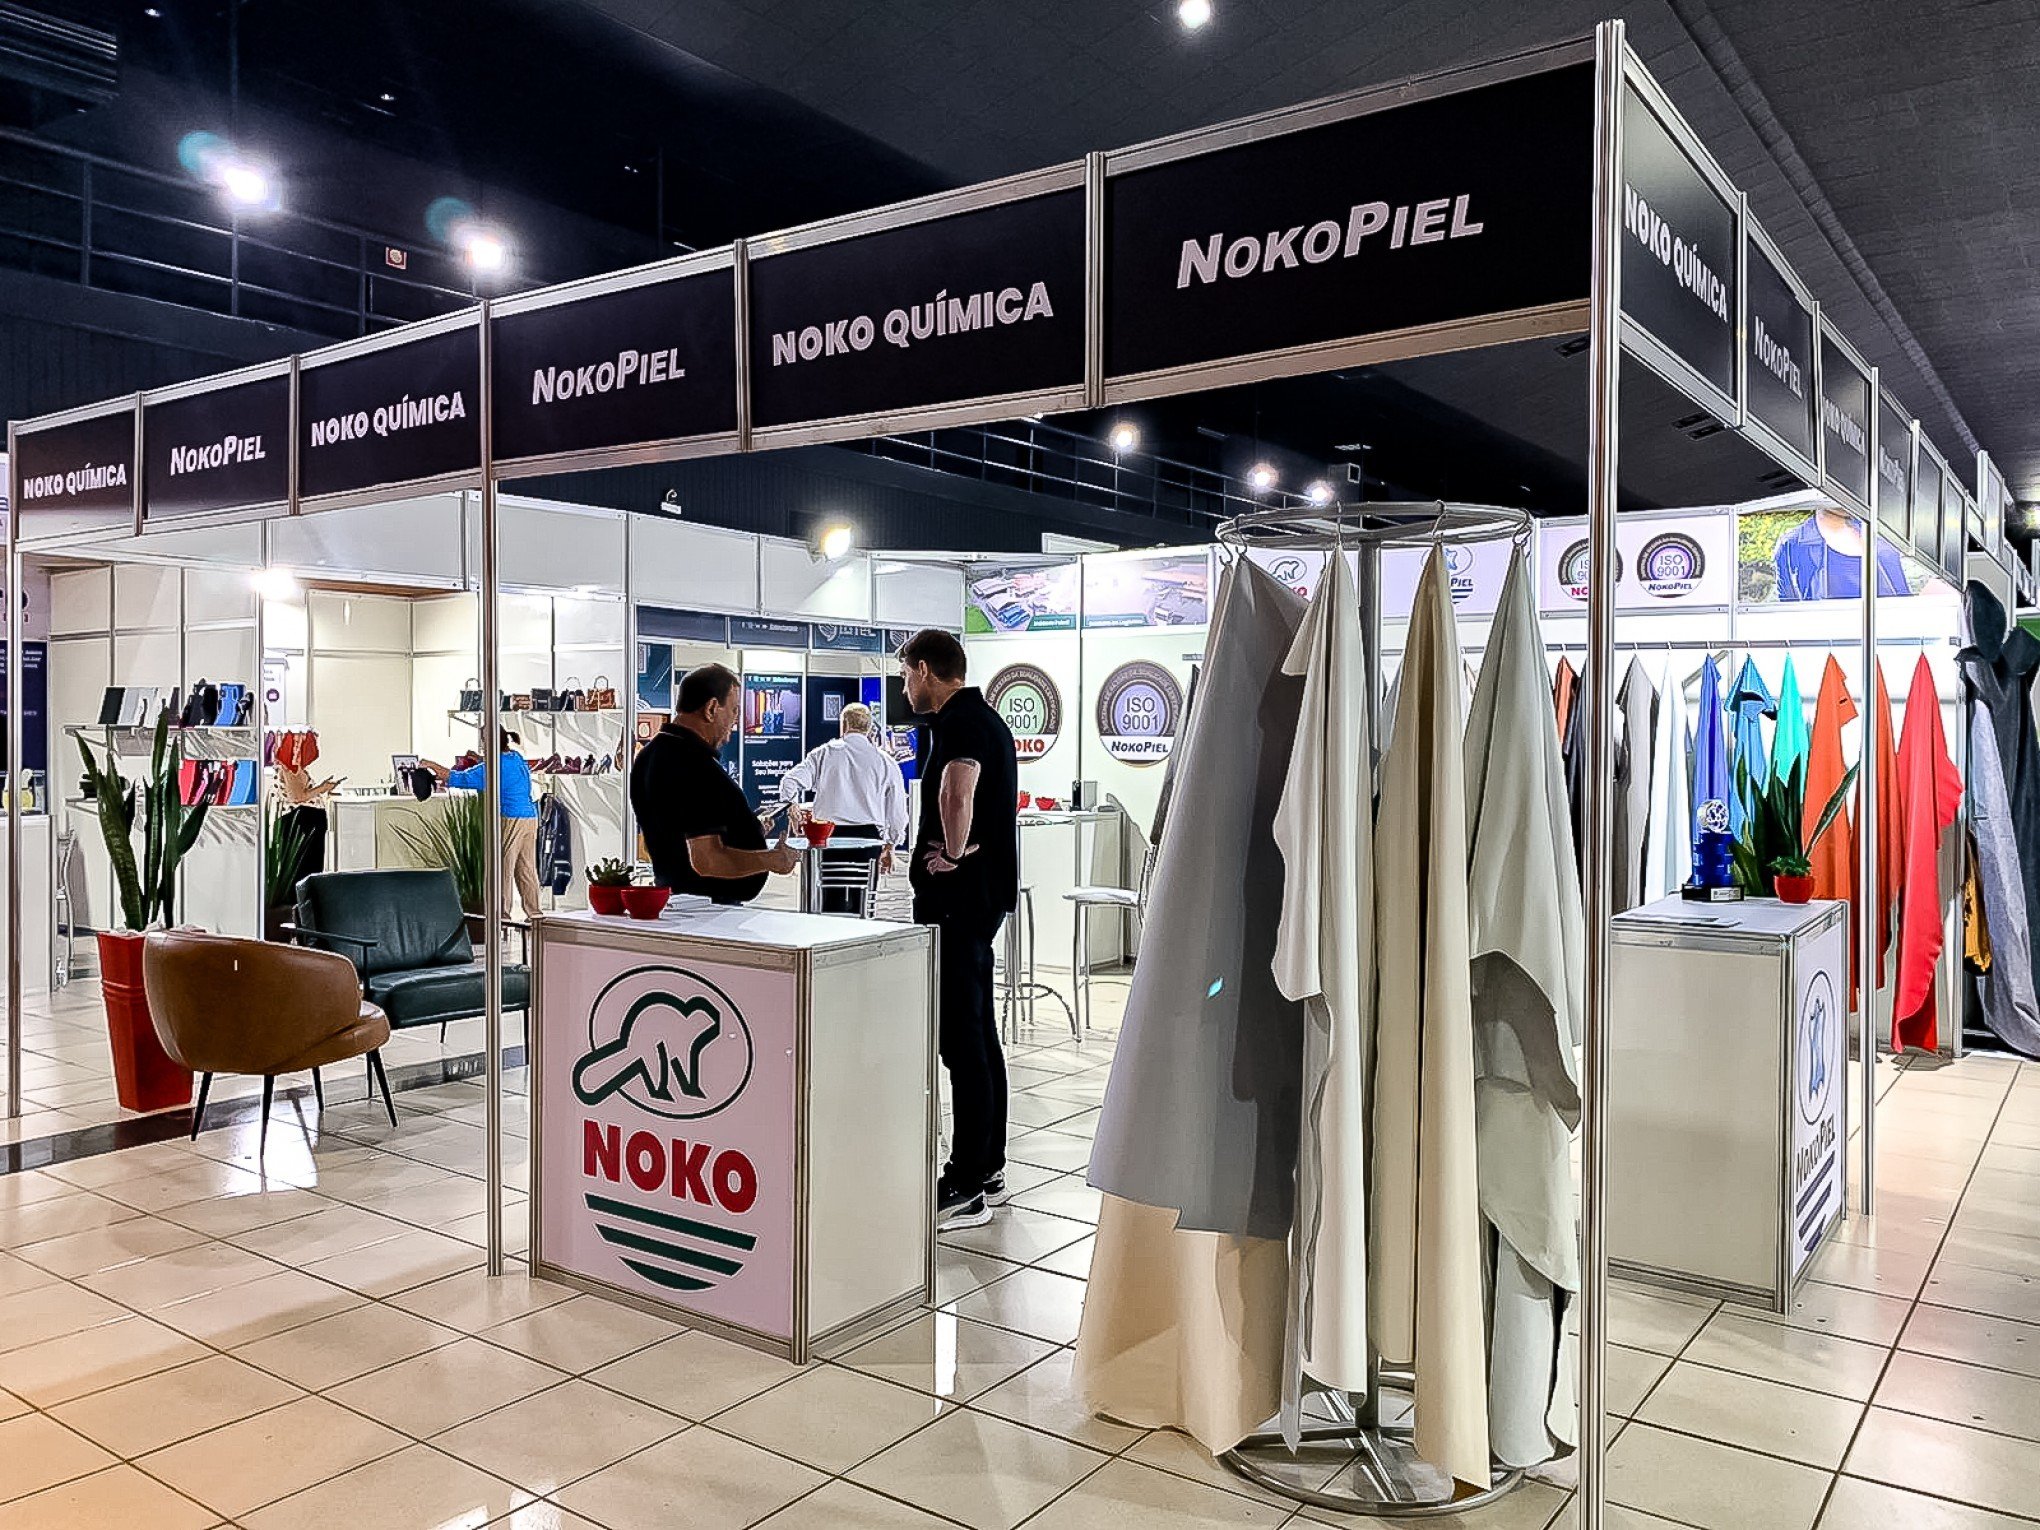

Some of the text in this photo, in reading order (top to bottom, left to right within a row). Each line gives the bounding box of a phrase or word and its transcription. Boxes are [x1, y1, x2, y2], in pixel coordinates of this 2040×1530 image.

[1625, 182, 1728, 323] NOKO QUÍMICA
[773, 281, 1054, 367] NOKO QUÍMICA
[311, 391, 466, 447] NOKO QUÍMICA
[23, 463, 127, 499] NOKO QUÍMICA
[1659, 554, 1683, 566] ISO
[1657, 565, 1685, 577] 9001
[1009, 697, 1035, 712] ISO
[1126, 697, 1155, 713] ISO
[1006, 714, 1038, 729] 9001
[1122, 714, 1159, 730] 9001
[584, 1119, 757, 1213] NOKO
